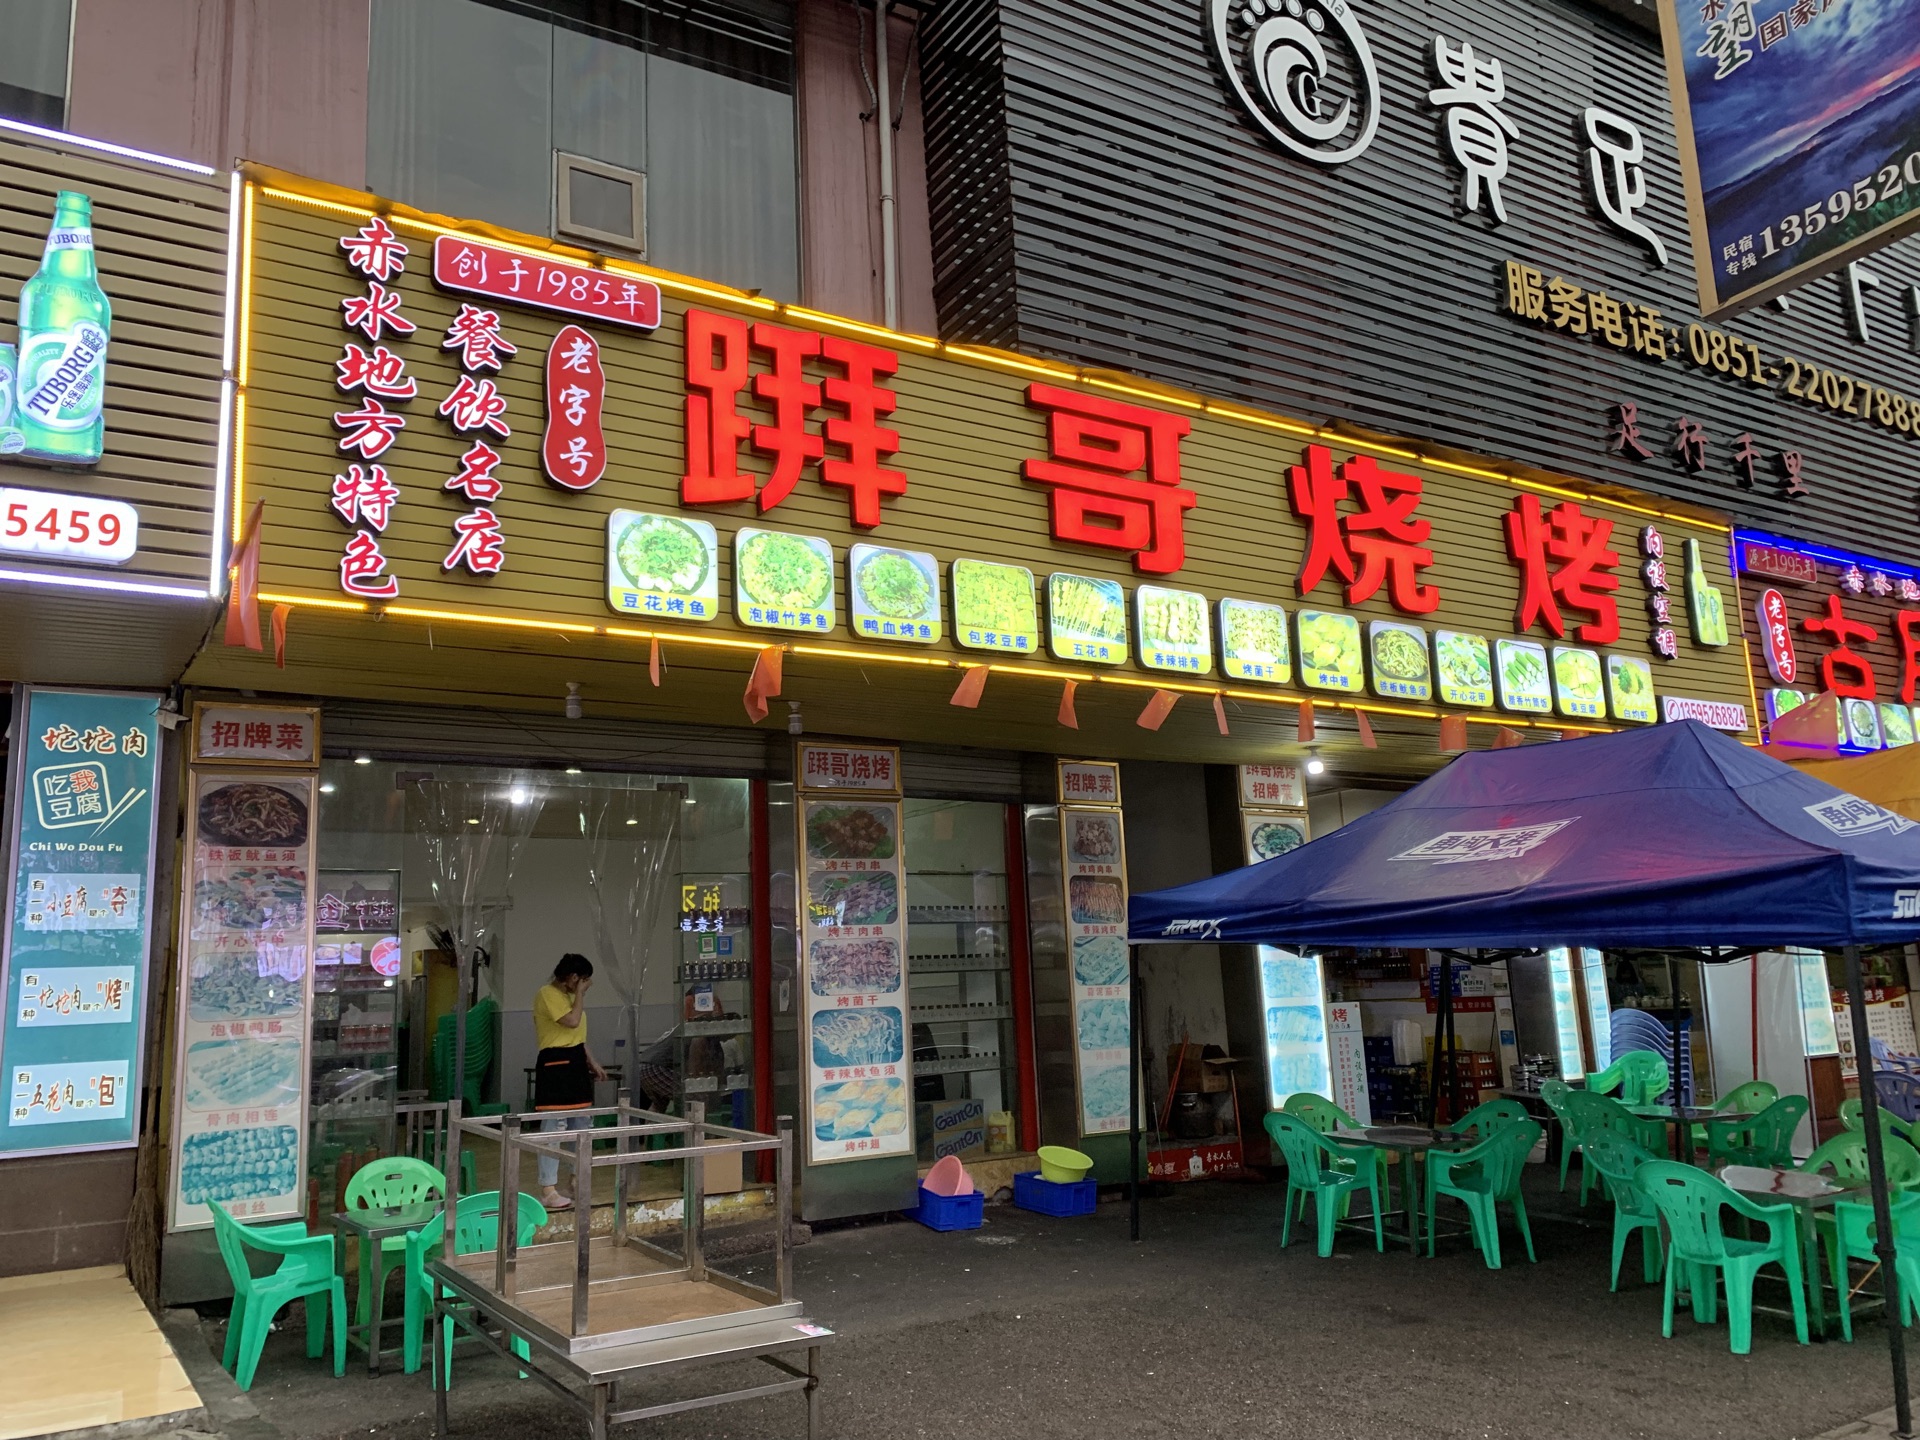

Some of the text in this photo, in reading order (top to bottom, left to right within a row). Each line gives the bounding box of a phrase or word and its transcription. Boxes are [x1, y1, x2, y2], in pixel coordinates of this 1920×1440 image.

[48, 233, 91, 246] TUBORG
[1723, 235, 1754, 261] 民宿
[1725, 252, 1758, 276] 专线
[450, 247, 647, 317] 创于1985年
[27, 345, 95, 417] TUBORG
[331, 217, 418, 598] 赤水地方特色
[559, 337, 597, 481] 老字号
[440, 303, 517, 573] 餐饮名店
[1645, 524, 1679, 660] 内设空调
[621, 592, 706, 617] 豆花烤鱼
[748, 607, 829, 630] 泡椒竹笋鱼
[863, 619, 933, 639] 鸭血烤鱼
[967, 630, 1028, 650] 包浆豆腐
[1768, 596, 1793, 676] 老字号
[1073, 643, 1110, 660] 五花肉
[1154, 652, 1200, 671] 香辣排骨
[1242, 663, 1275, 679] 烤菌干
[1318, 672, 1350, 688] 烤中翅
[1449, 689, 1487, 704] 开心花甲
[1679, 702, 1747, 729] 13595268824
[41, 724, 147, 758] 坨坨肉
[211, 720, 303, 750] 招牌菜
[1065, 771, 1114, 794] 招牌菜
[1252, 781, 1293, 801] 招牌菜
[29, 842, 123, 852] Chi Wo Dou Fu
[825, 860, 881, 871] 烤牛肉串
[827, 926, 884, 938] 烤羊肉串
[836, 994, 879, 1007] 烤菌干
[823, 1065, 897, 1081] 香辣鱿鱼须
[844, 1138, 881, 1153] 烤中翅
